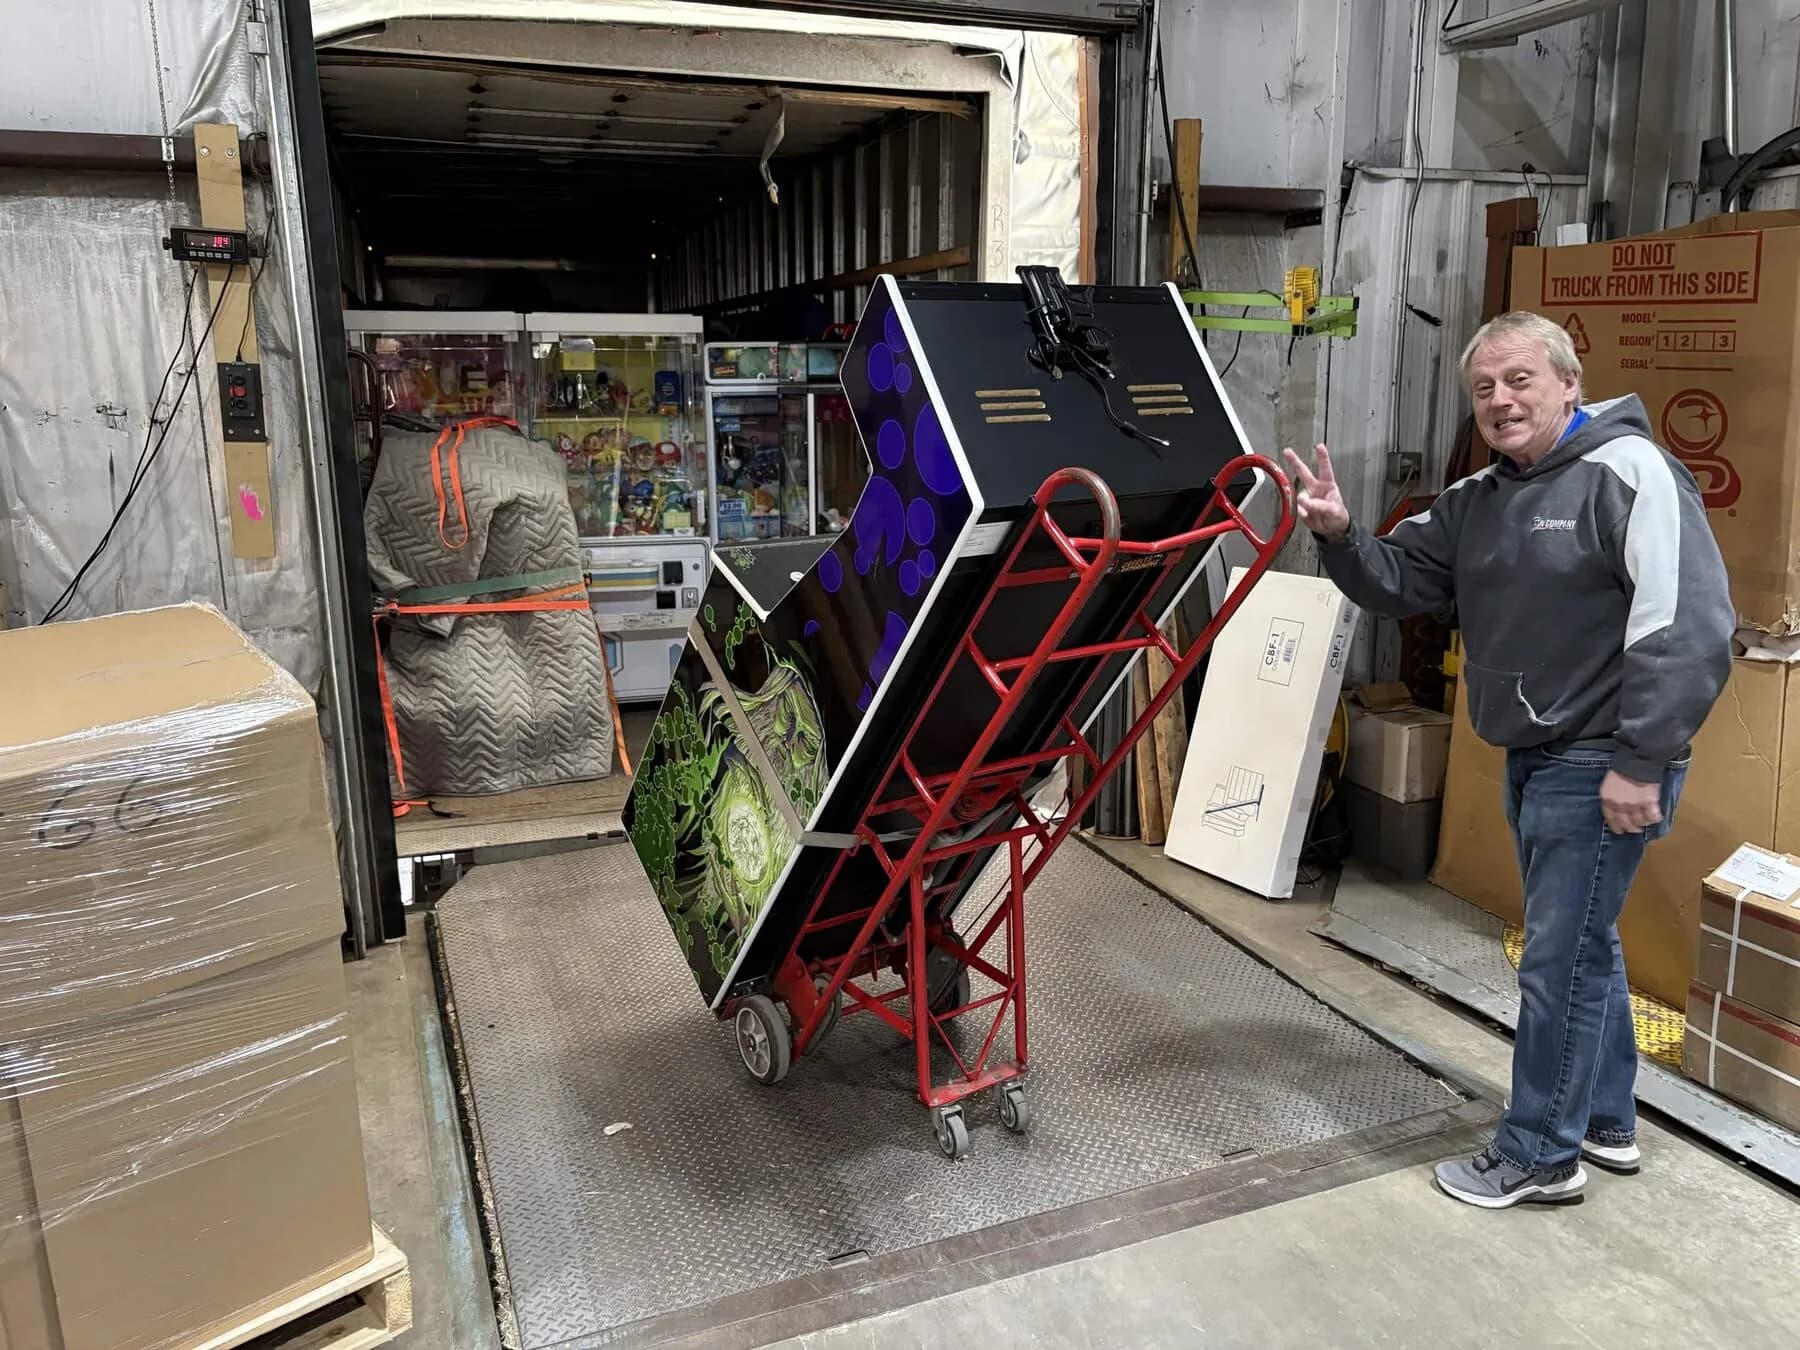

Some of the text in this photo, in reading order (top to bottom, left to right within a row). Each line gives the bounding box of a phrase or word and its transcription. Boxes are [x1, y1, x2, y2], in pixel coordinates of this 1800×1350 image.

[991, 205, 1004, 232] R
[990, 240, 1005, 268] 3
[1612, 243, 1676, 266] DO NOT
[1551, 271, 1749, 297] TRUCK FROM THIS SIDE
[1663, 336, 1670, 347] 1
[1680, 336, 1690, 347] 2
[1719, 336, 1729, 347] 3
[1265, 633, 1280, 665] CBF-1
[1330, 634, 1344, 668] CBF-1
